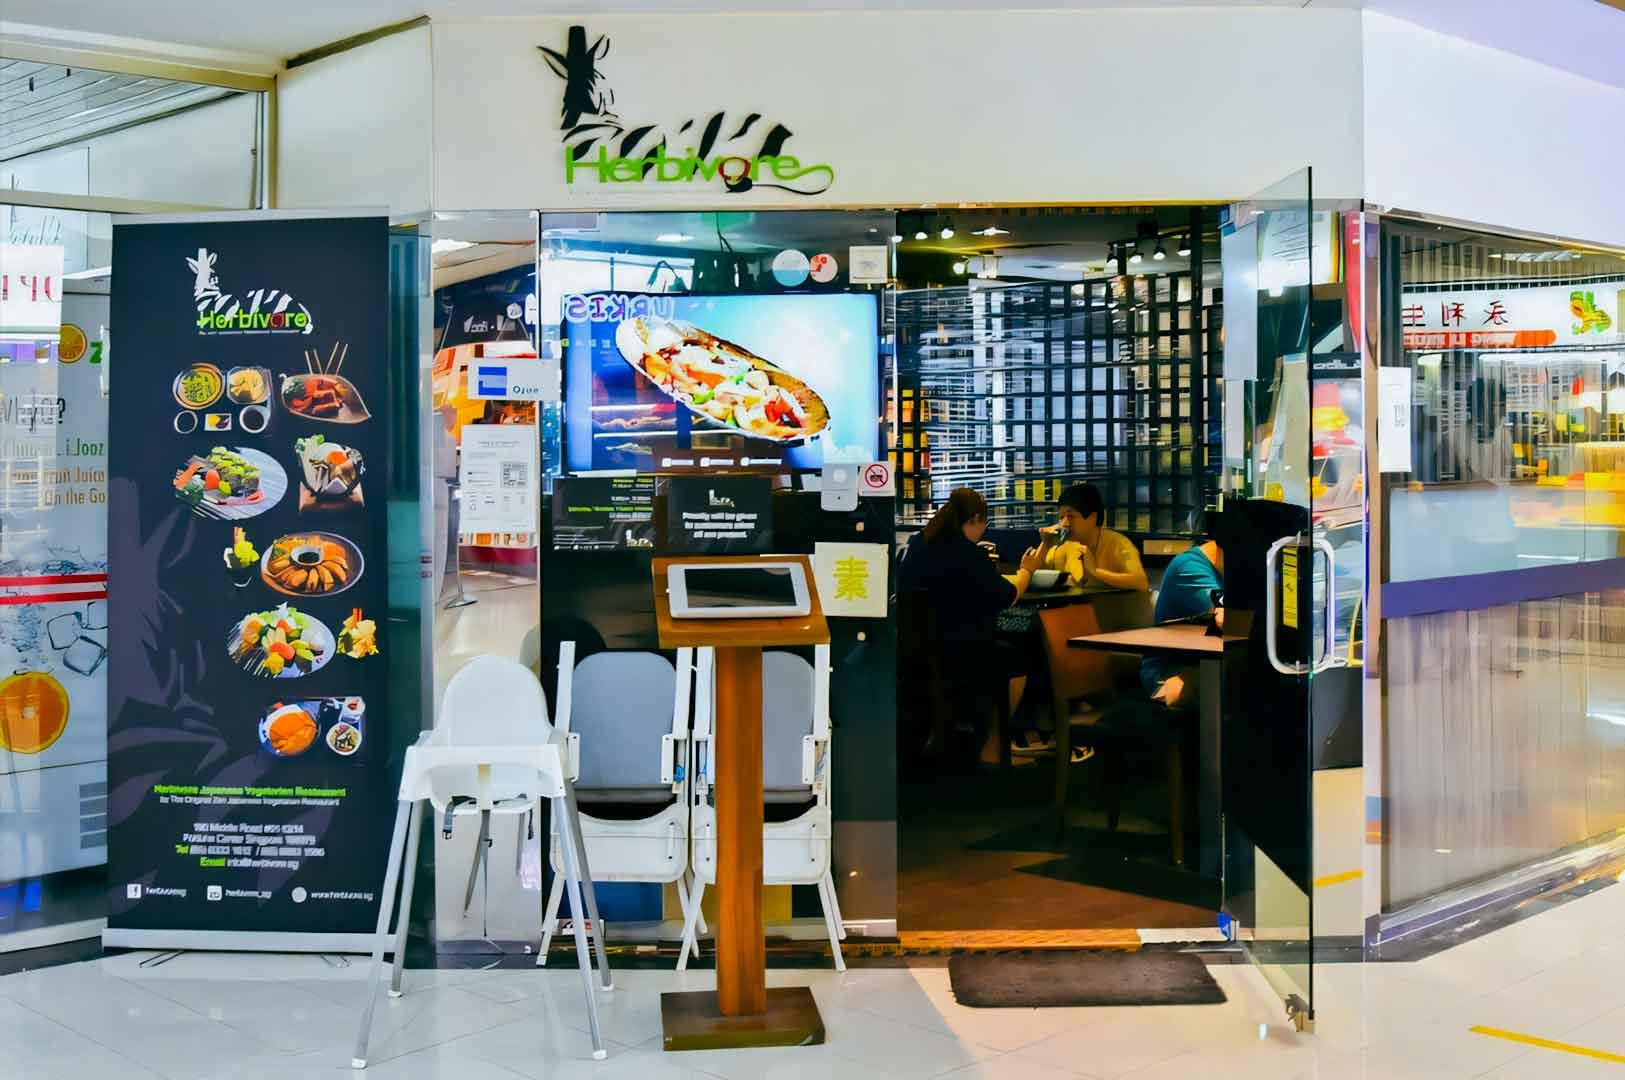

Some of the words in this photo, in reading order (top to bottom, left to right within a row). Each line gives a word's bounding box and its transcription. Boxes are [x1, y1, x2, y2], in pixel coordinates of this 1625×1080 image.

[565, 144, 833, 190] Herbivore
[196, 309, 308, 329] Herbivore
[834, 555, 869, 601] 素
